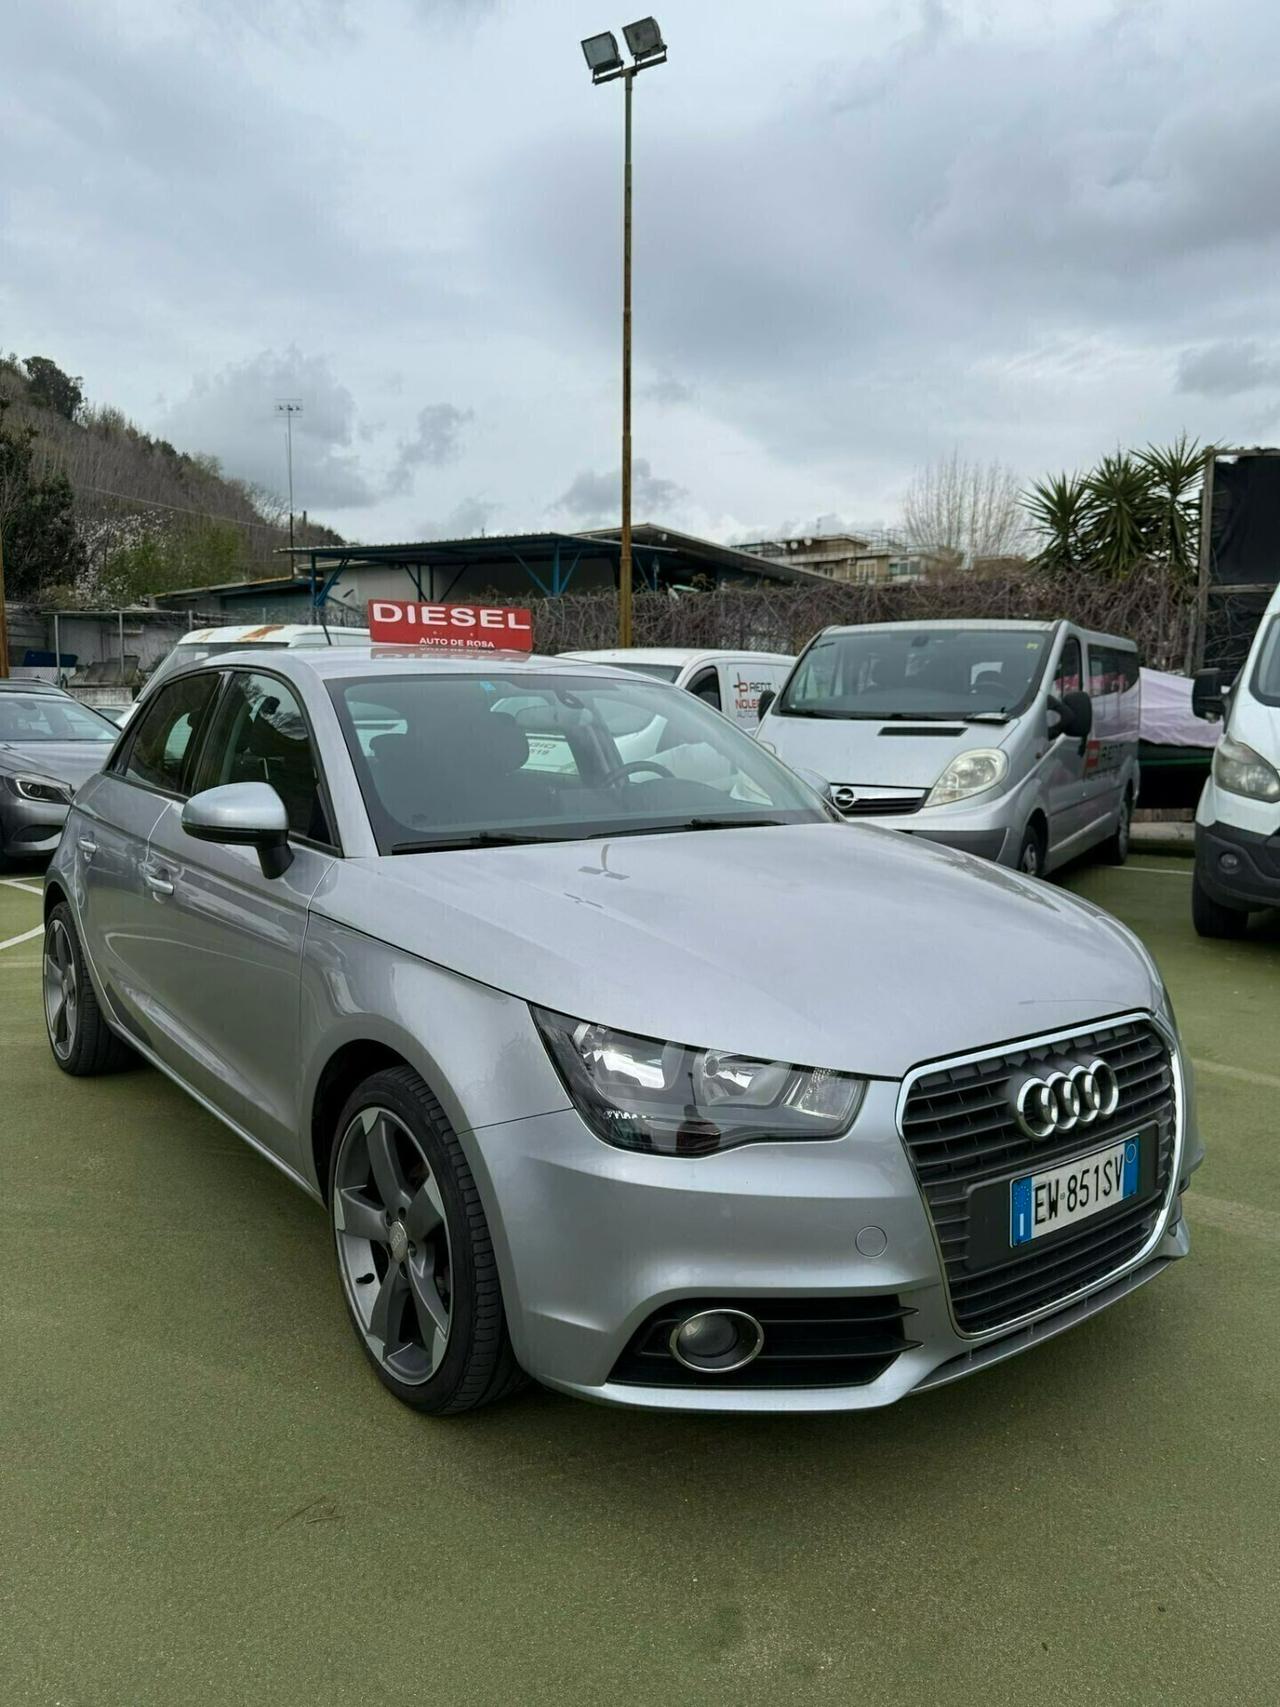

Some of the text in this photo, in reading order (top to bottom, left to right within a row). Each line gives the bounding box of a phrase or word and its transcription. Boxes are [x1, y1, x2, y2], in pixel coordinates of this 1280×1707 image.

[372, 603, 531, 630] DIESEL
[419, 637, 496, 648] AUTO DE ROSA
